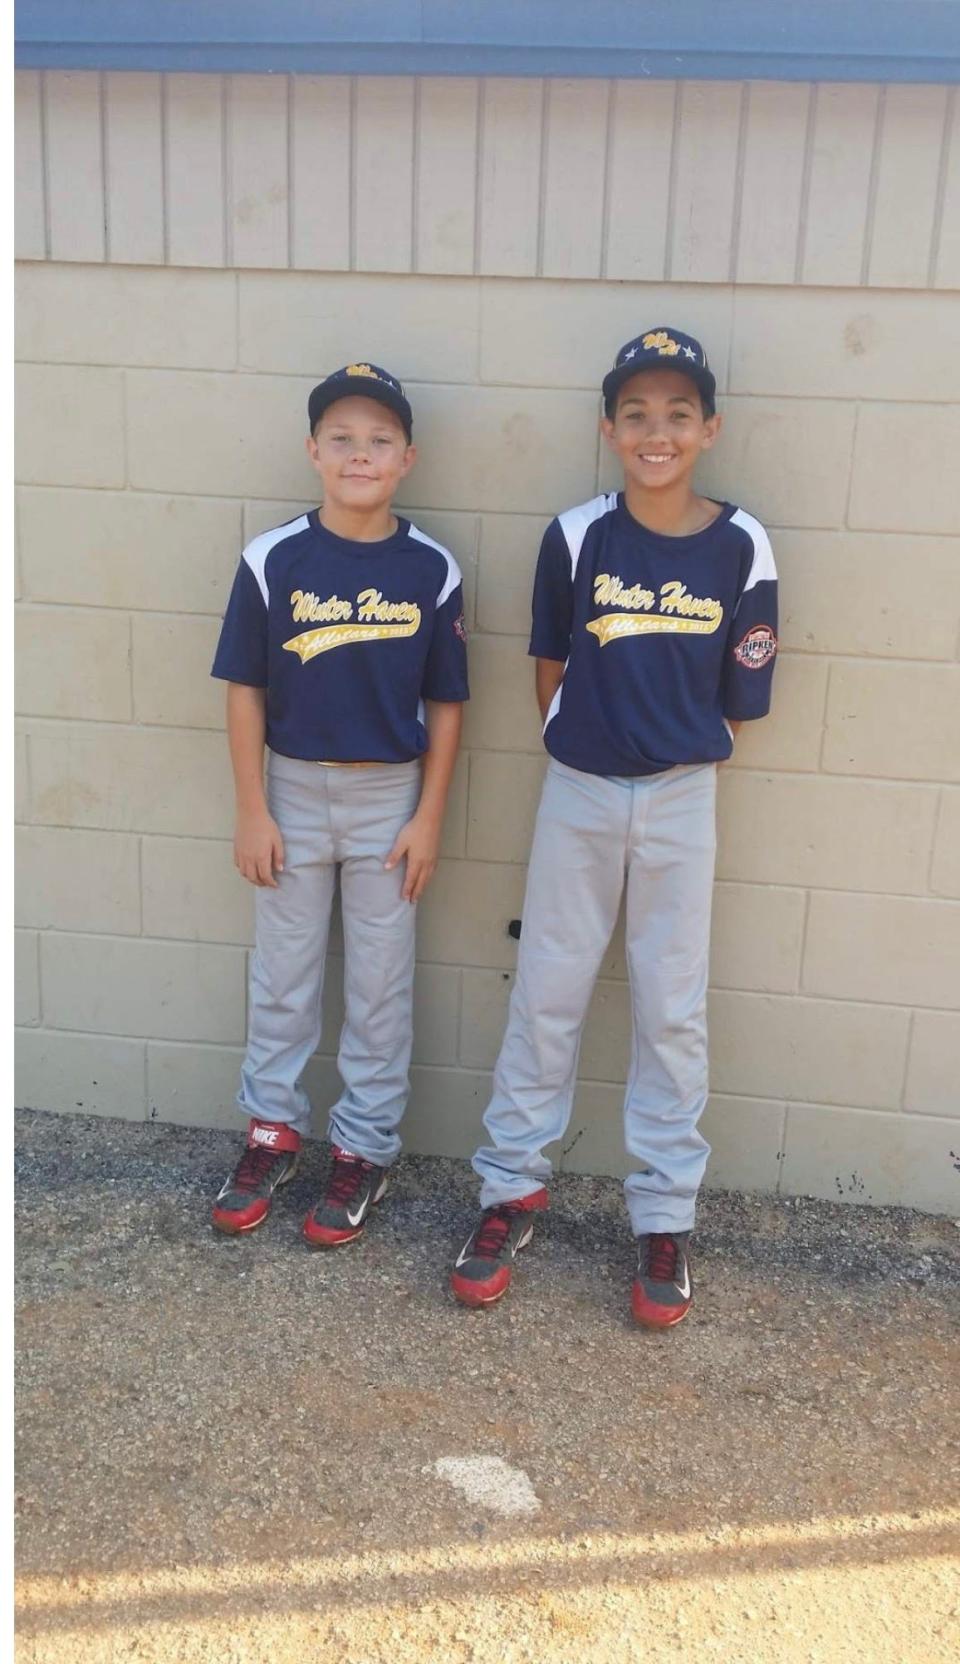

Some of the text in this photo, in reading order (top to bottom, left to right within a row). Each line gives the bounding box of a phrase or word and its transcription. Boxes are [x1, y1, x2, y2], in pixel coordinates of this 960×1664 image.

[290, 588, 419, 622] Winter Haven
[593, 573, 721, 618] Winter Haven
[252, 1126, 280, 1146] NIKE
